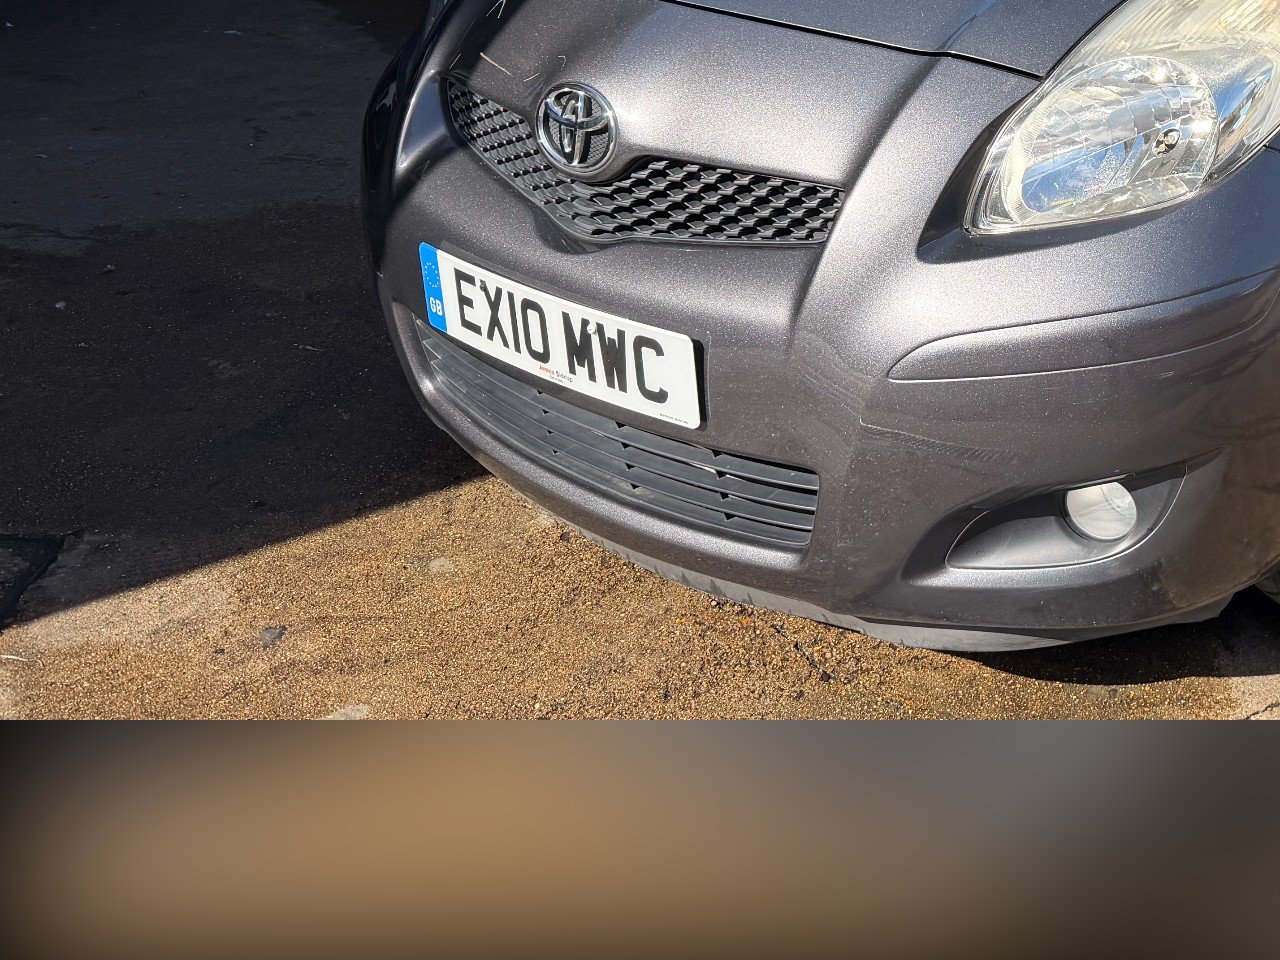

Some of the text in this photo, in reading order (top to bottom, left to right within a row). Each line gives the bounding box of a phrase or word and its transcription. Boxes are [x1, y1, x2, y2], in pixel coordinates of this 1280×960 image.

[429, 296, 443, 316] GB
[453, 267, 669, 404] EX10 MWC
